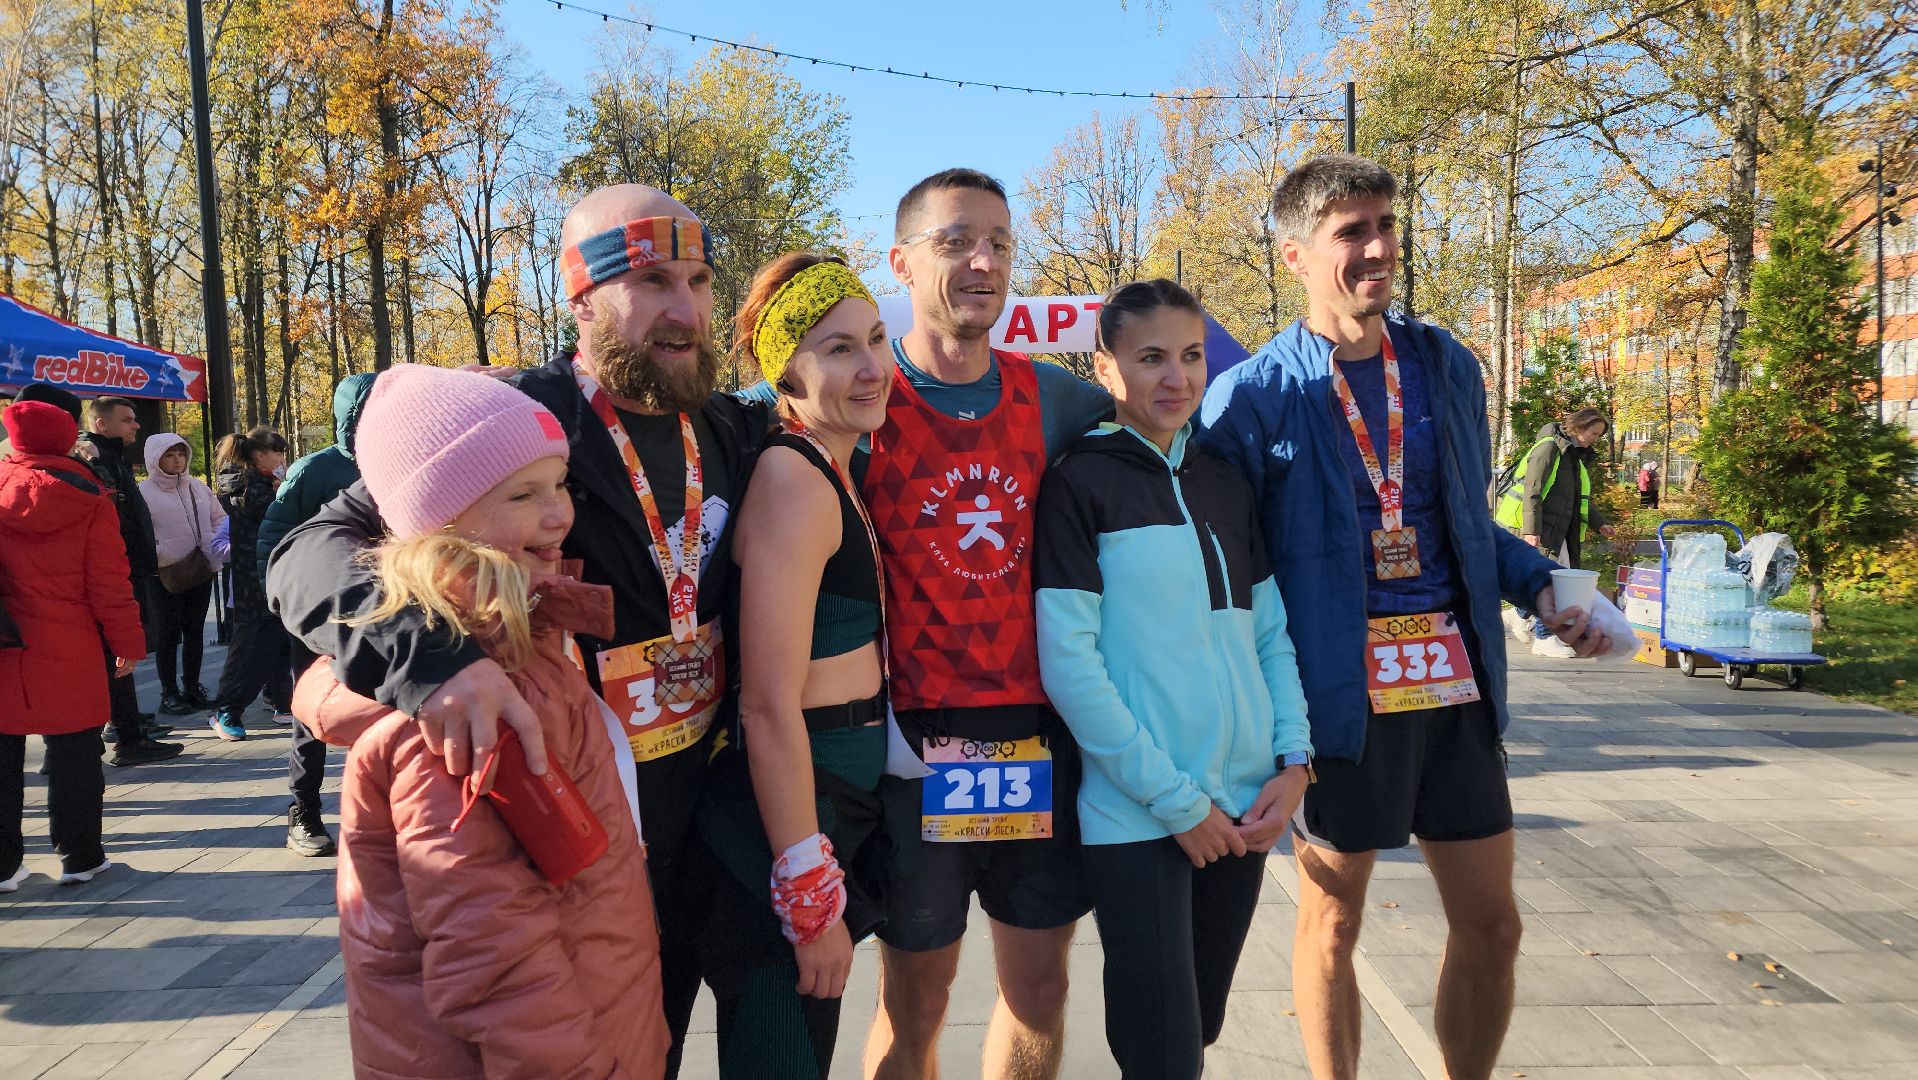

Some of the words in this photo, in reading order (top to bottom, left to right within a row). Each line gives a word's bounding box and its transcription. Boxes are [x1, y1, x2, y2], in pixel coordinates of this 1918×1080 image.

[33, 350, 149, 390] redBike
[921, 463, 1027, 517] KLMNRUN
[929, 541, 950, 567] КЛУБ
[1374, 641, 1454, 683] 332
[627, 677, 695, 726] 3
[944, 766, 1032, 809] 213
